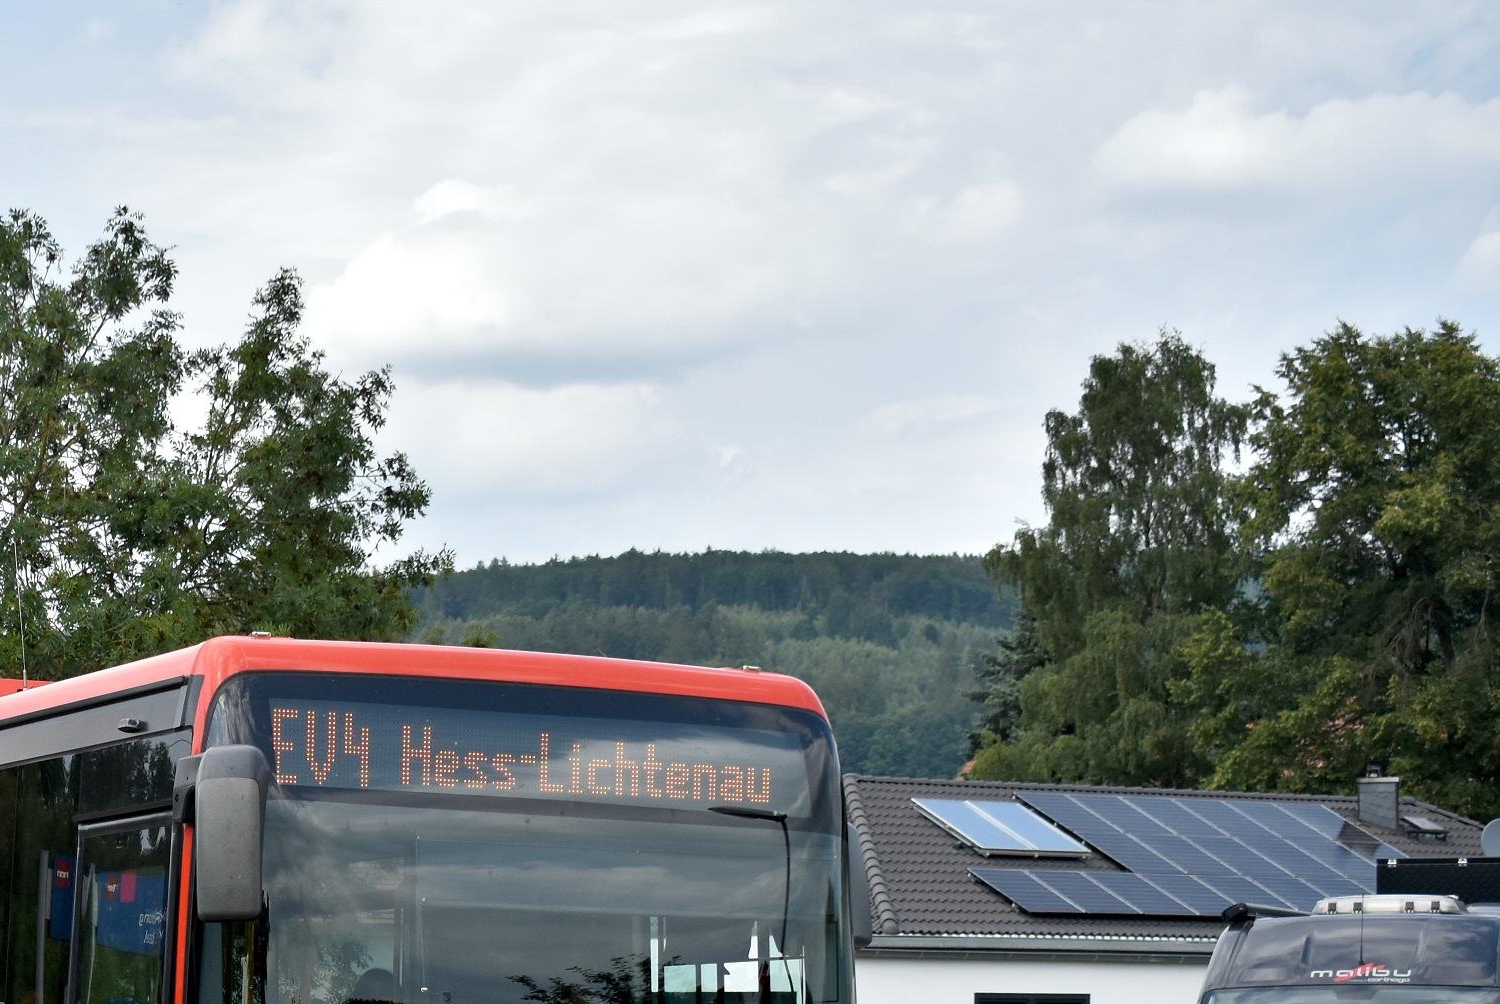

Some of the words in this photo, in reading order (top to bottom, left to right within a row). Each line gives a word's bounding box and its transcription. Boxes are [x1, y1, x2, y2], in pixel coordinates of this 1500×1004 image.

[272, 707, 370, 789] EV4
[402, 724, 772, 804] Hess-Lichtenau
[1310, 966, 1412, 978] malibu
